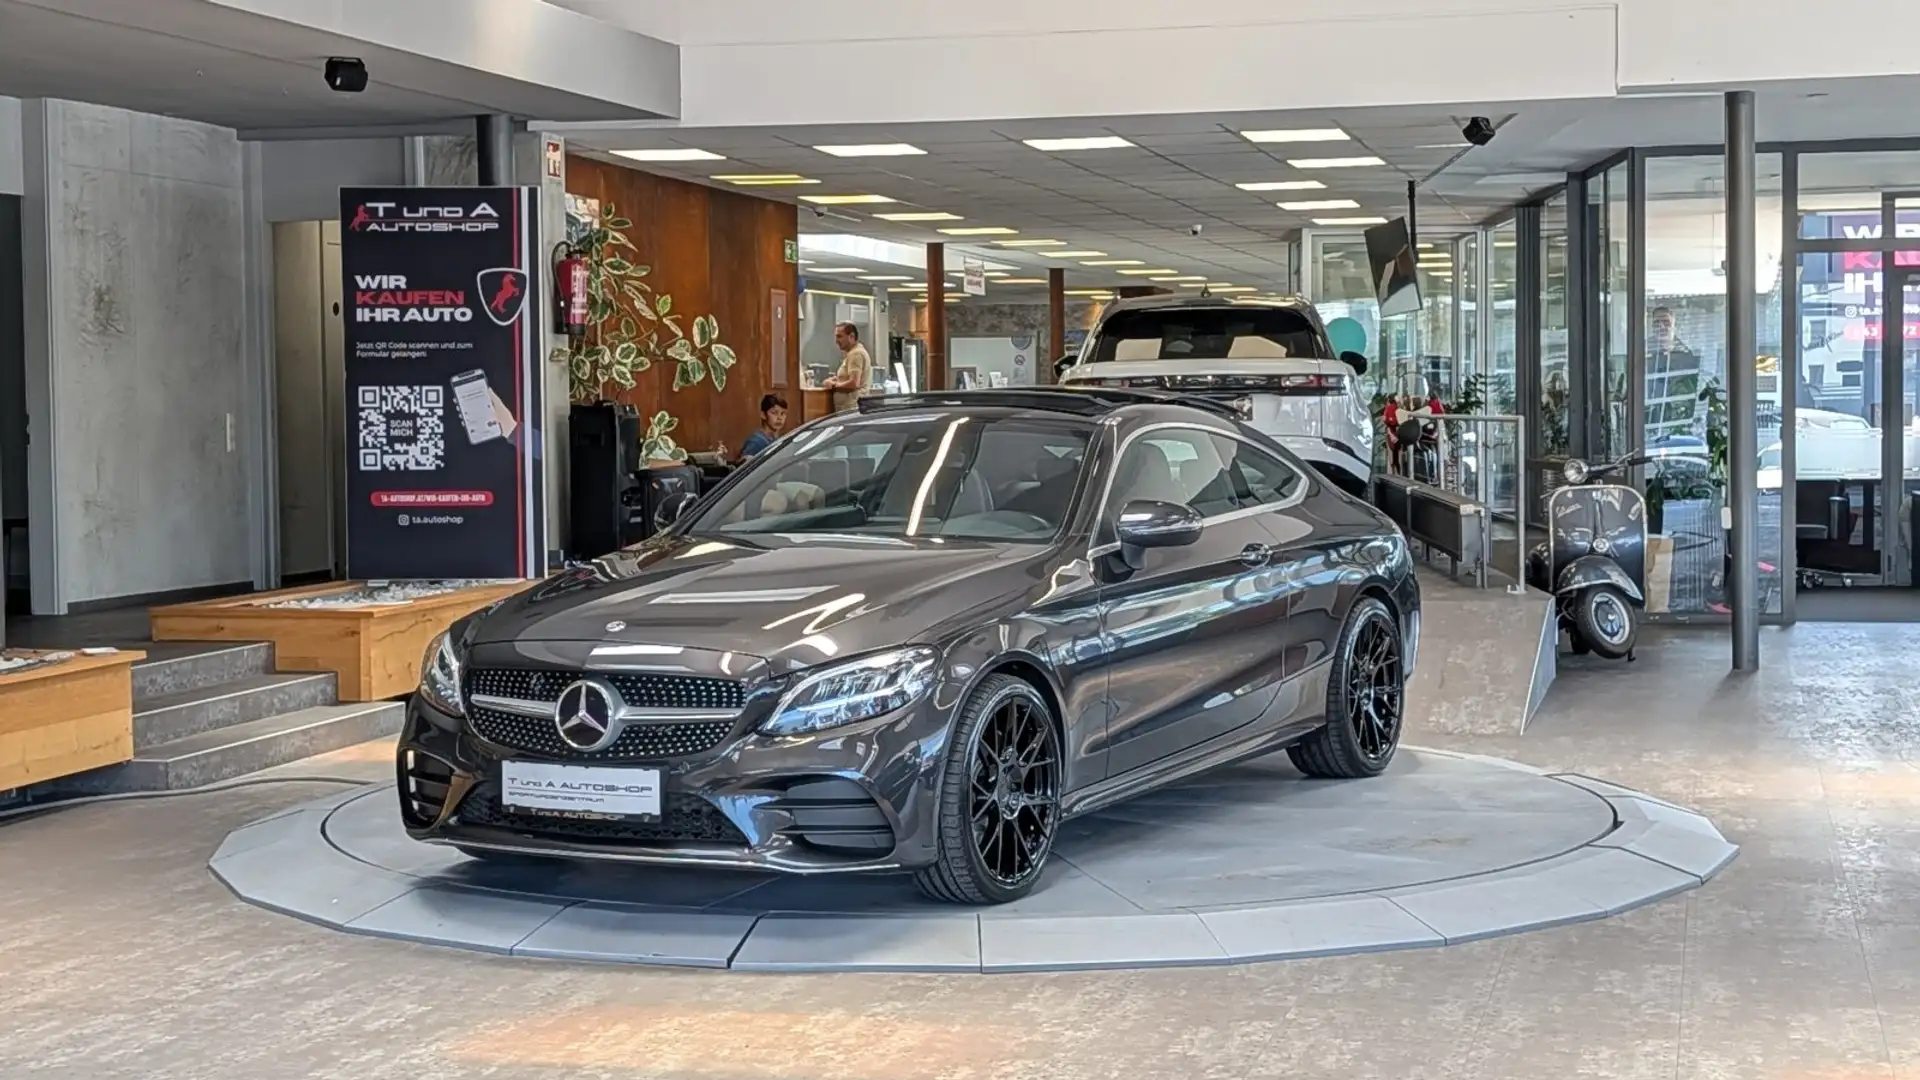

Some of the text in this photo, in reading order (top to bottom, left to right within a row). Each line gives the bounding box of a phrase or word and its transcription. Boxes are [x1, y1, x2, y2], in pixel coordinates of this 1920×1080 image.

[366, 202, 396, 217] T
[469, 202, 499, 217] A
[366, 222, 499, 232] AUTOSHOP
[354, 275, 407, 289] WIR
[355, 291, 465, 305] KAUFEN
[356, 308, 473, 322] IHR AUTO
[356, 341, 374, 349] Jetzt
[375, 341, 387, 349] QR
[388, 341, 407, 349] Code
[440, 341, 455, 349] und
[356, 350, 389, 358] Formular
[390, 419, 413, 428] SCAN
[390, 428, 413, 437] MICH
[412, 514, 464, 525] ta.autoshop
[545, 780, 555, 788] A
[560, 782, 653, 793] AUTOSHOP
